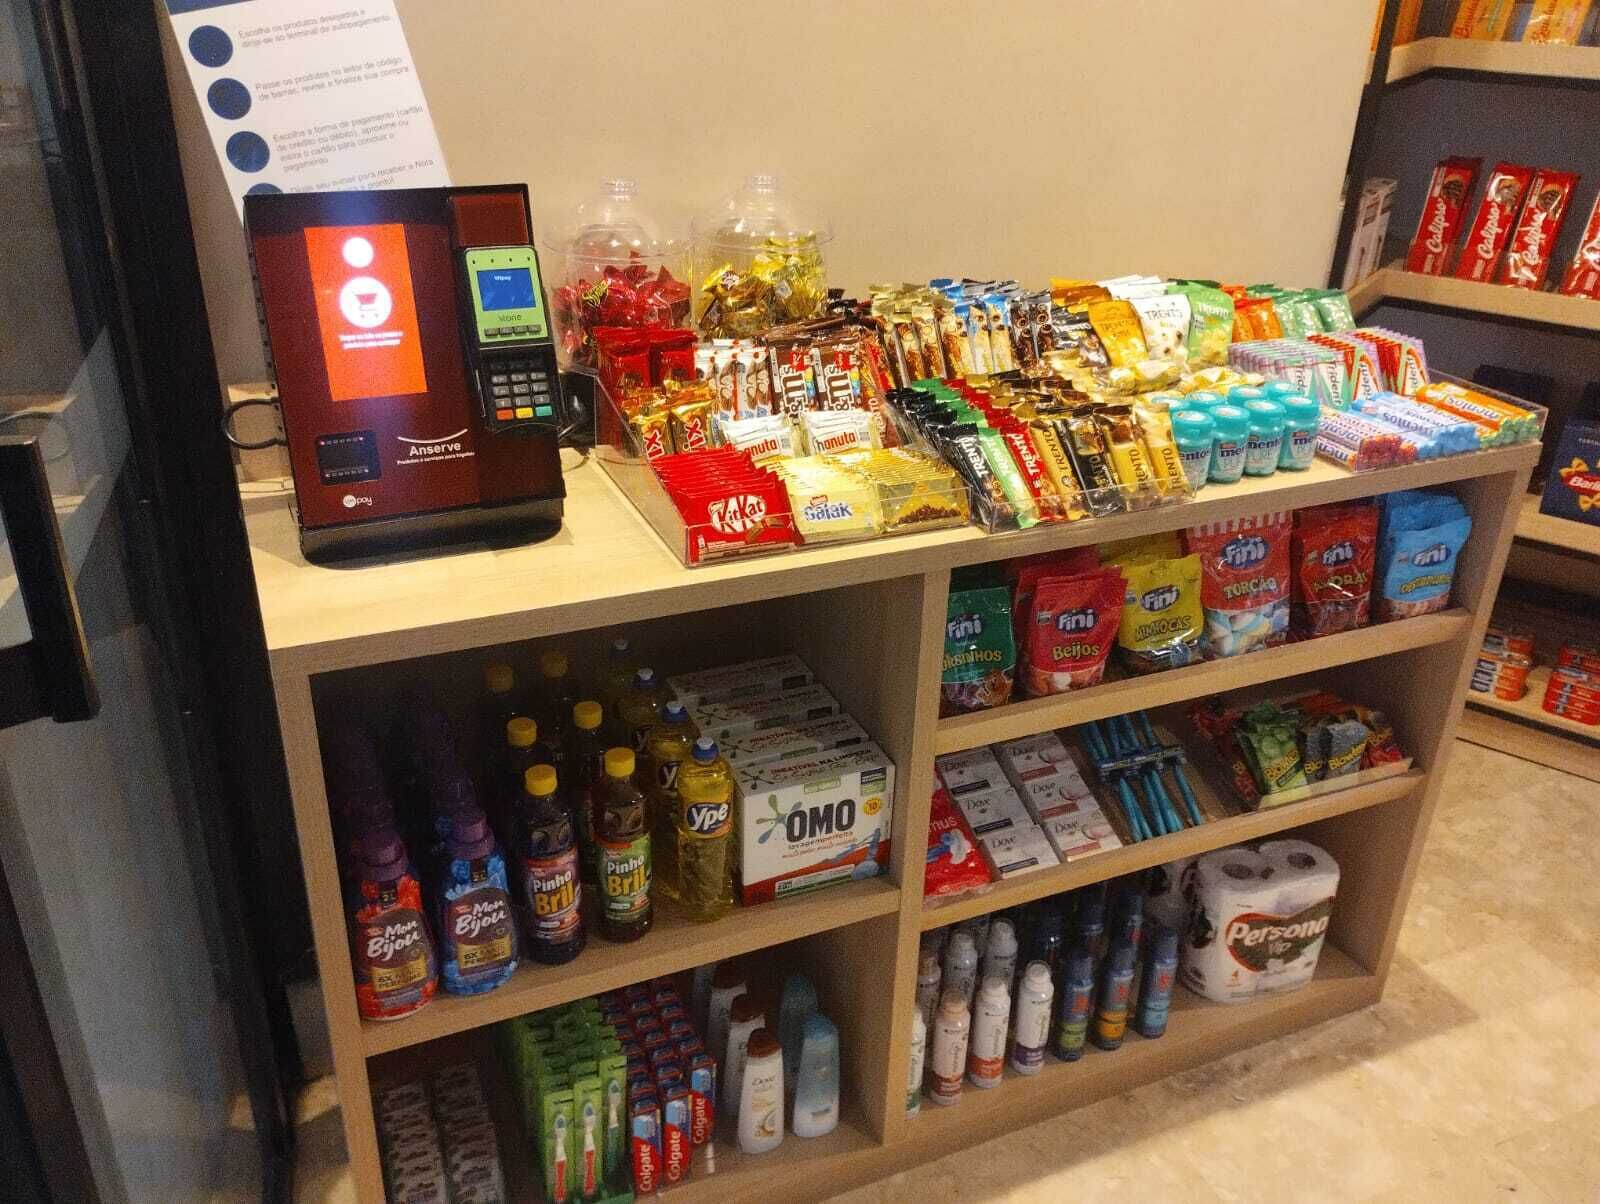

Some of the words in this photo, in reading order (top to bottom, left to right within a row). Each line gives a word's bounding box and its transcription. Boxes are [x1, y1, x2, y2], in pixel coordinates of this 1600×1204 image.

[284, 19, 318, 32] produtos
[255, 80, 281, 90] Passe
[294, 70, 330, 85] produtos
[351, 112, 397, 128] pagamento
[377, 164, 405, 178] receber
[414, 158, 434, 169] Nota
[1327, 360, 1345, 408] Trident
[1383, 412, 1434, 436] mentos
[409, 442, 462, 457] Anserve
[741, 438, 779, 457] anuta
[814, 431, 856, 455] hanuta
[1006, 433, 1040, 476] TRENTO
[1043, 429, 1069, 472] TRENTO
[960, 436, 989, 478] TRENTO
[1162, 447, 1182, 490] TRENTO
[1052, 642, 1100, 661] Beijos
[786, 798, 856, 843] OMO
[606, 856, 645, 874] Pinho
[533, 870, 572, 893] Pinho
[607, 864, 646, 897] Bril
[472, 900, 504, 917] Mon
[535, 880, 574, 916] Bril
[384, 920, 418, 938] Mon
[455, 910, 508, 939] Bijou
[367, 931, 421, 962] Bijou
[693, 1097, 707, 1145] Colgate
[640, 1144, 656, 1192] Colgate
[667, 1130, 684, 1181] Colgate
